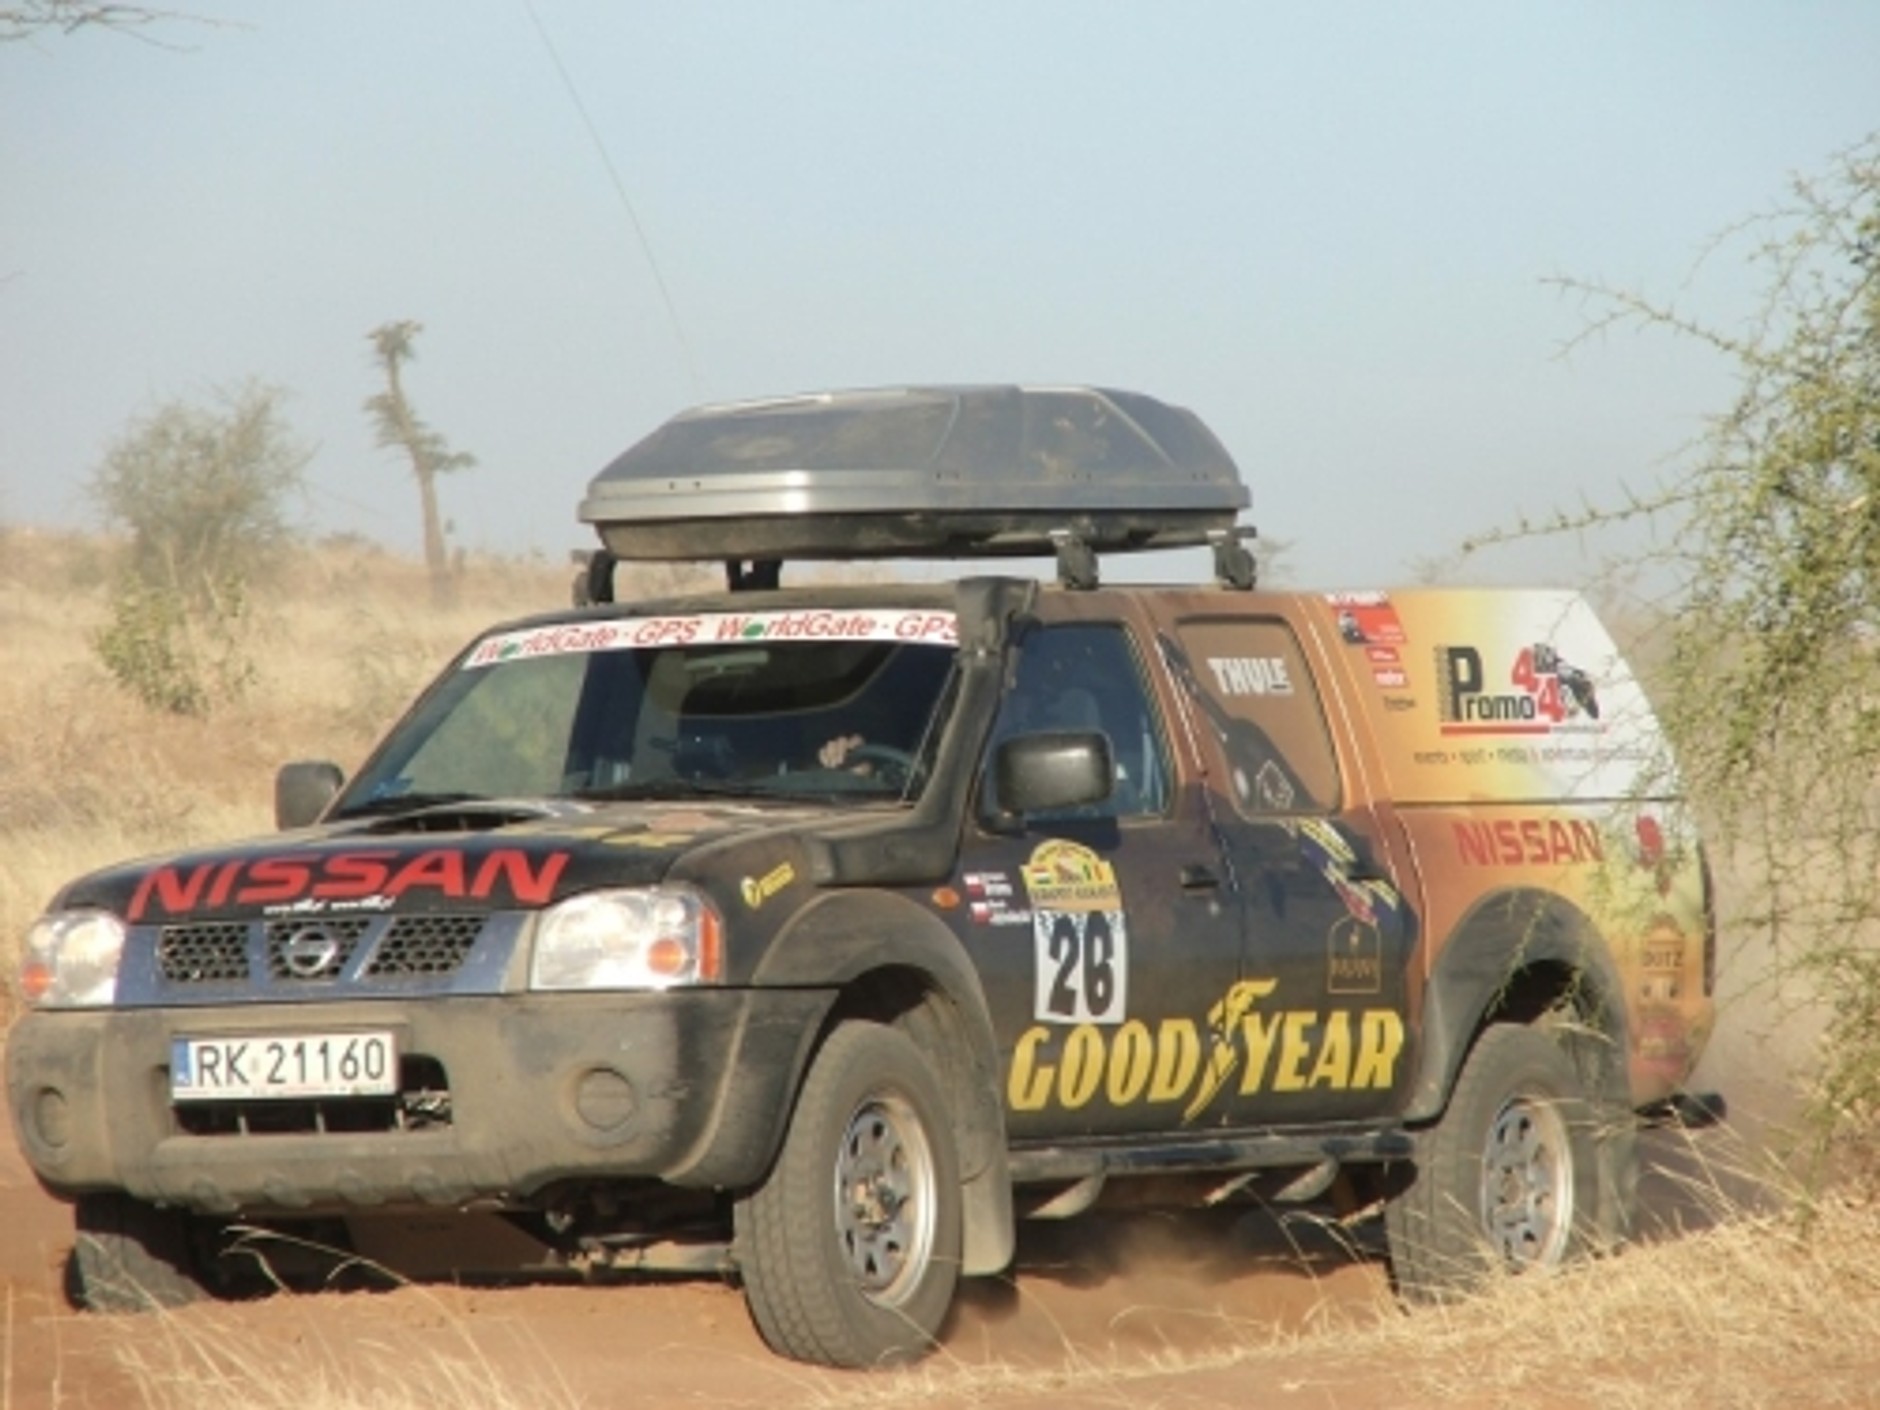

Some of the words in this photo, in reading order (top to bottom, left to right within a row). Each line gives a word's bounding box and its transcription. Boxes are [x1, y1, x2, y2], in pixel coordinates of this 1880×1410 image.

[633, 620, 701, 645] GPS
[1207, 657, 1293, 694] THULE
[1451, 820, 1604, 866] NISSAN
[128, 848, 569, 921] NISSAN
[197, 1042, 250, 1087] RK
[266, 1038, 385, 1084] 21160
